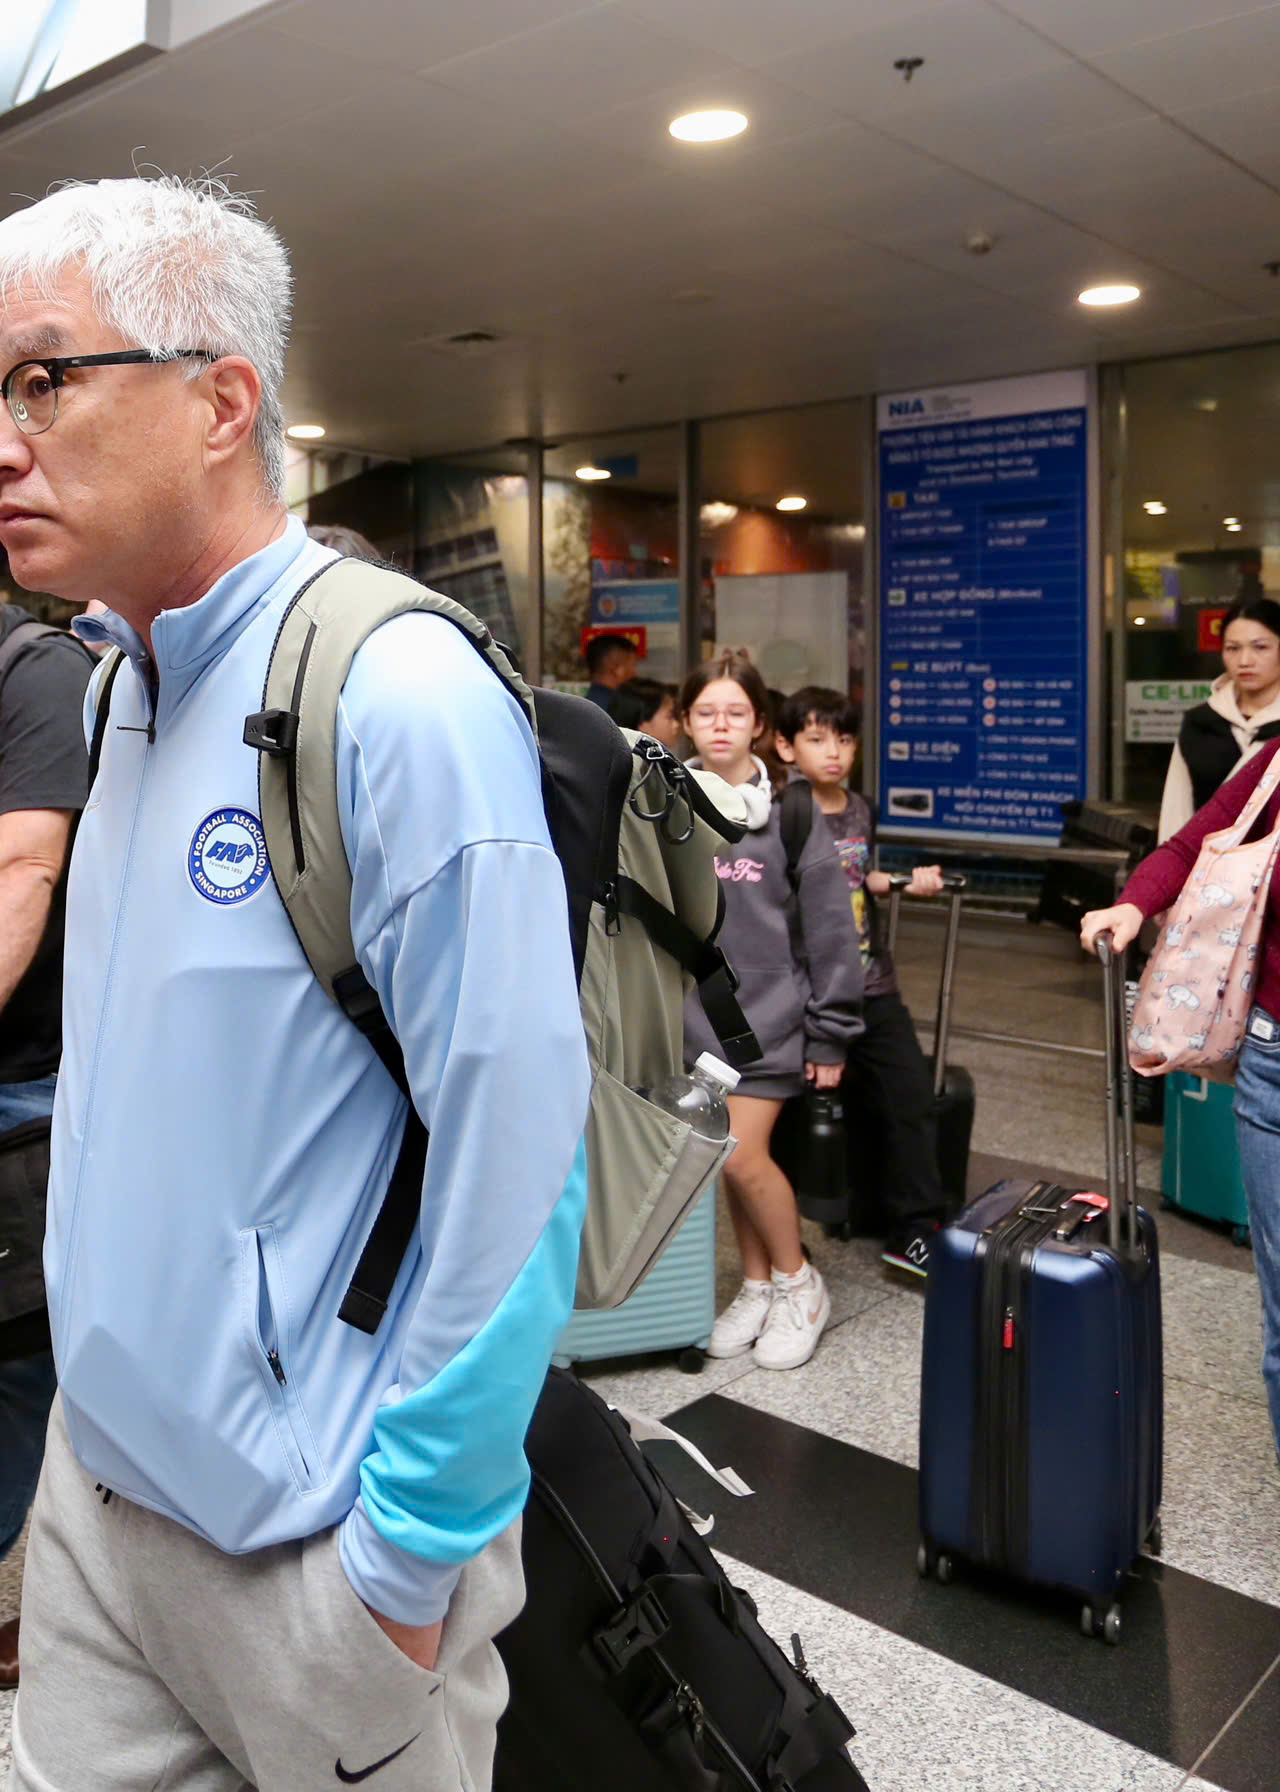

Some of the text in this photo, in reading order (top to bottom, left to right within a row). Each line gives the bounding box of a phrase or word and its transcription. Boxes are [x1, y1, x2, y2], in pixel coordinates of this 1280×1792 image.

[913, 661, 928, 673] XE
[913, 742, 928, 754] XE
[194, 814, 227, 856] FOOTBALL
[232, 814, 267, 876] ASSOCIATION
[195, 872, 248, 899] SINGAPORE
